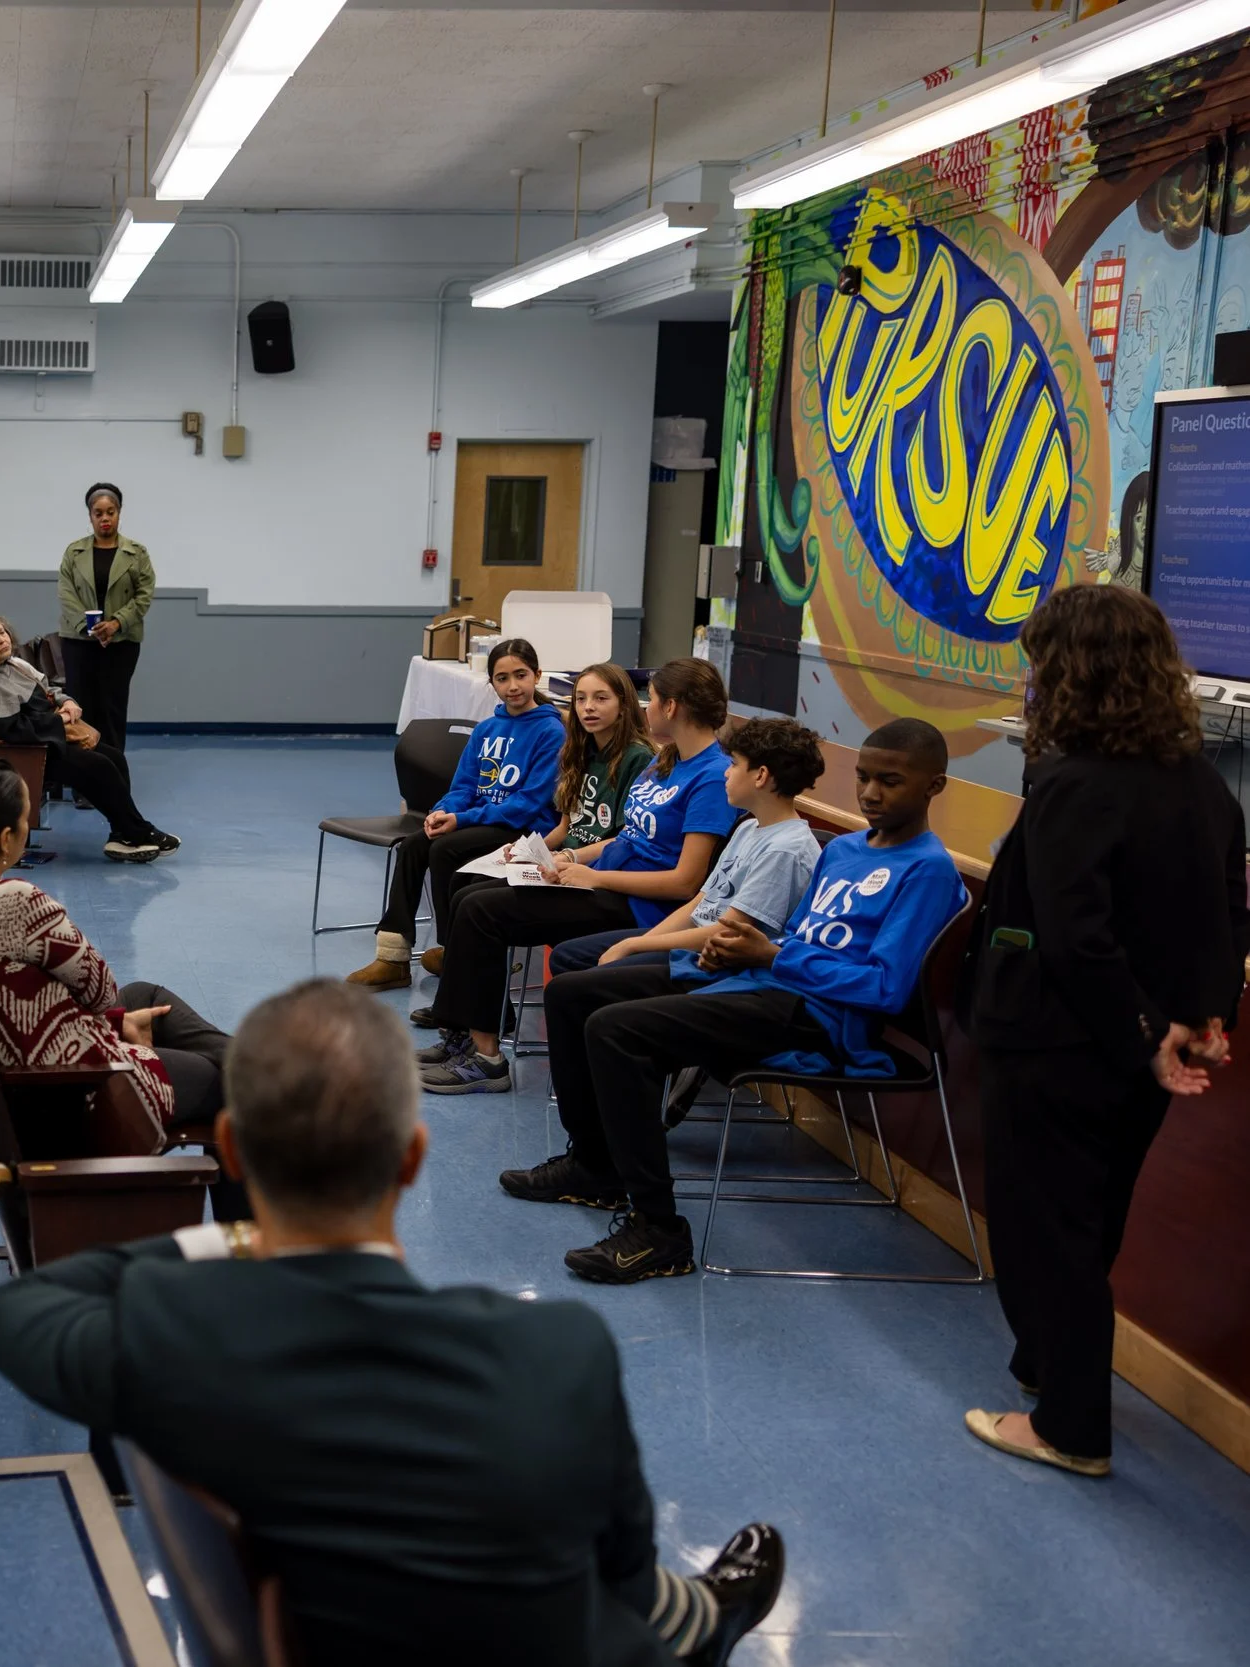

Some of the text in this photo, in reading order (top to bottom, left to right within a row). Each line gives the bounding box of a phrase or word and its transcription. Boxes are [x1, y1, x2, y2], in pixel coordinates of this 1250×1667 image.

[818, 187, 1070, 625] PURSUE
[1171, 414, 1203, 433] Panel
[1168, 461, 1211, 471] Collaboration
[1212, 460, 1225, 471] and
[1165, 505, 1189, 515] Teacher
[1190, 506, 1215, 516] support
[1216, 505, 1229, 515] and
[1159, 573, 1186, 586] Creating
[1187, 576, 1231, 587] opportunities
[1231, 577, 1242, 588] for
[1190, 619, 1215, 630] teacher
[1216, 622, 1237, 632] teams
[1237, 624, 1246, 633] to
